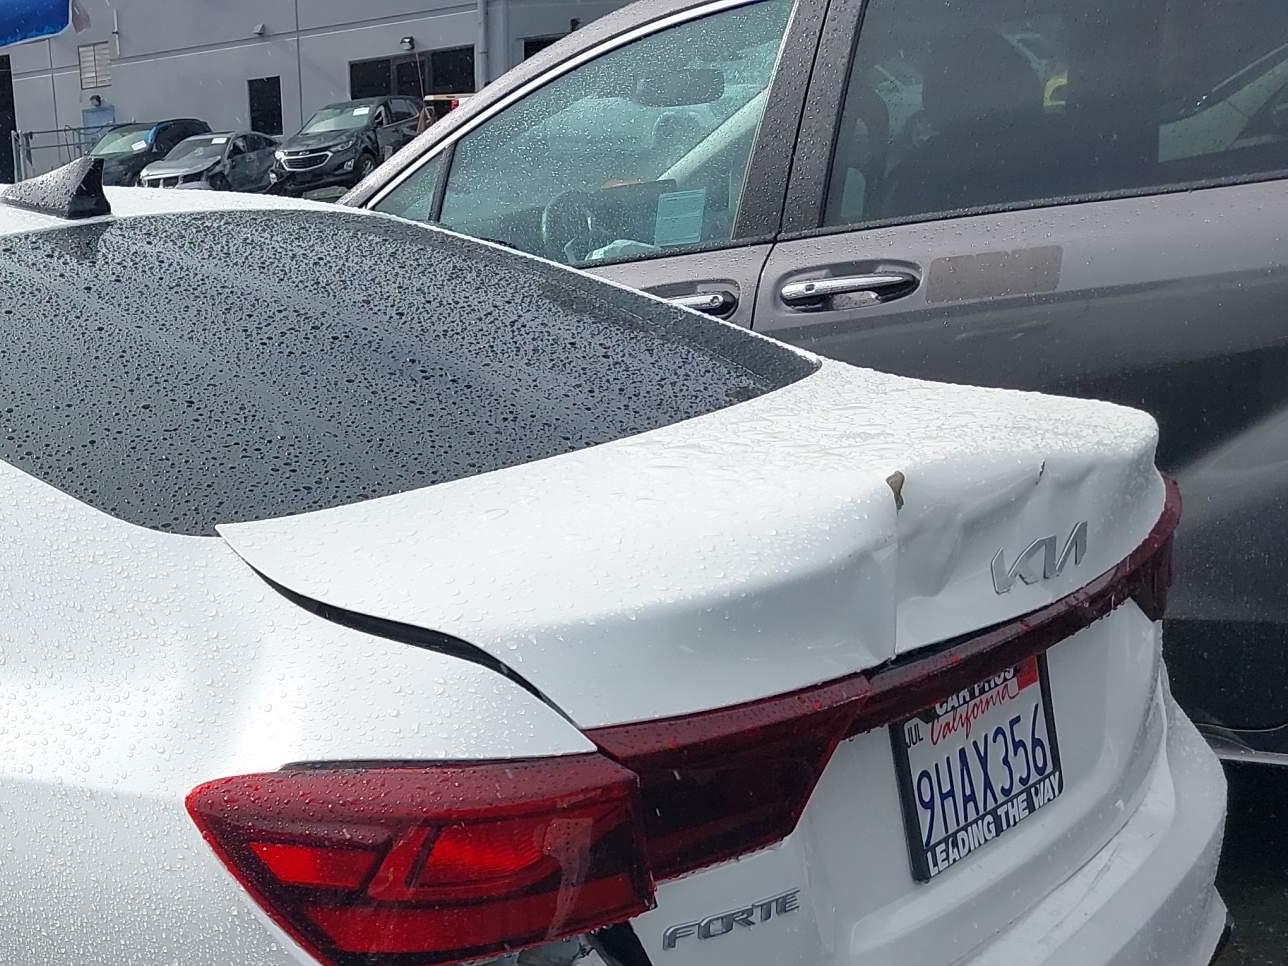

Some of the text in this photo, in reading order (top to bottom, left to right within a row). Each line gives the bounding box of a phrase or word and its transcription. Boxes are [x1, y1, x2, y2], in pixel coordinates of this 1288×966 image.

[904, 723, 924, 749] JUL
[930, 682, 1021, 746] California
[916, 703, 1048, 848] 9HAX356
[926, 771, 1062, 877] LEADING THE WAY
[662, 888, 800, 951] FORTE
